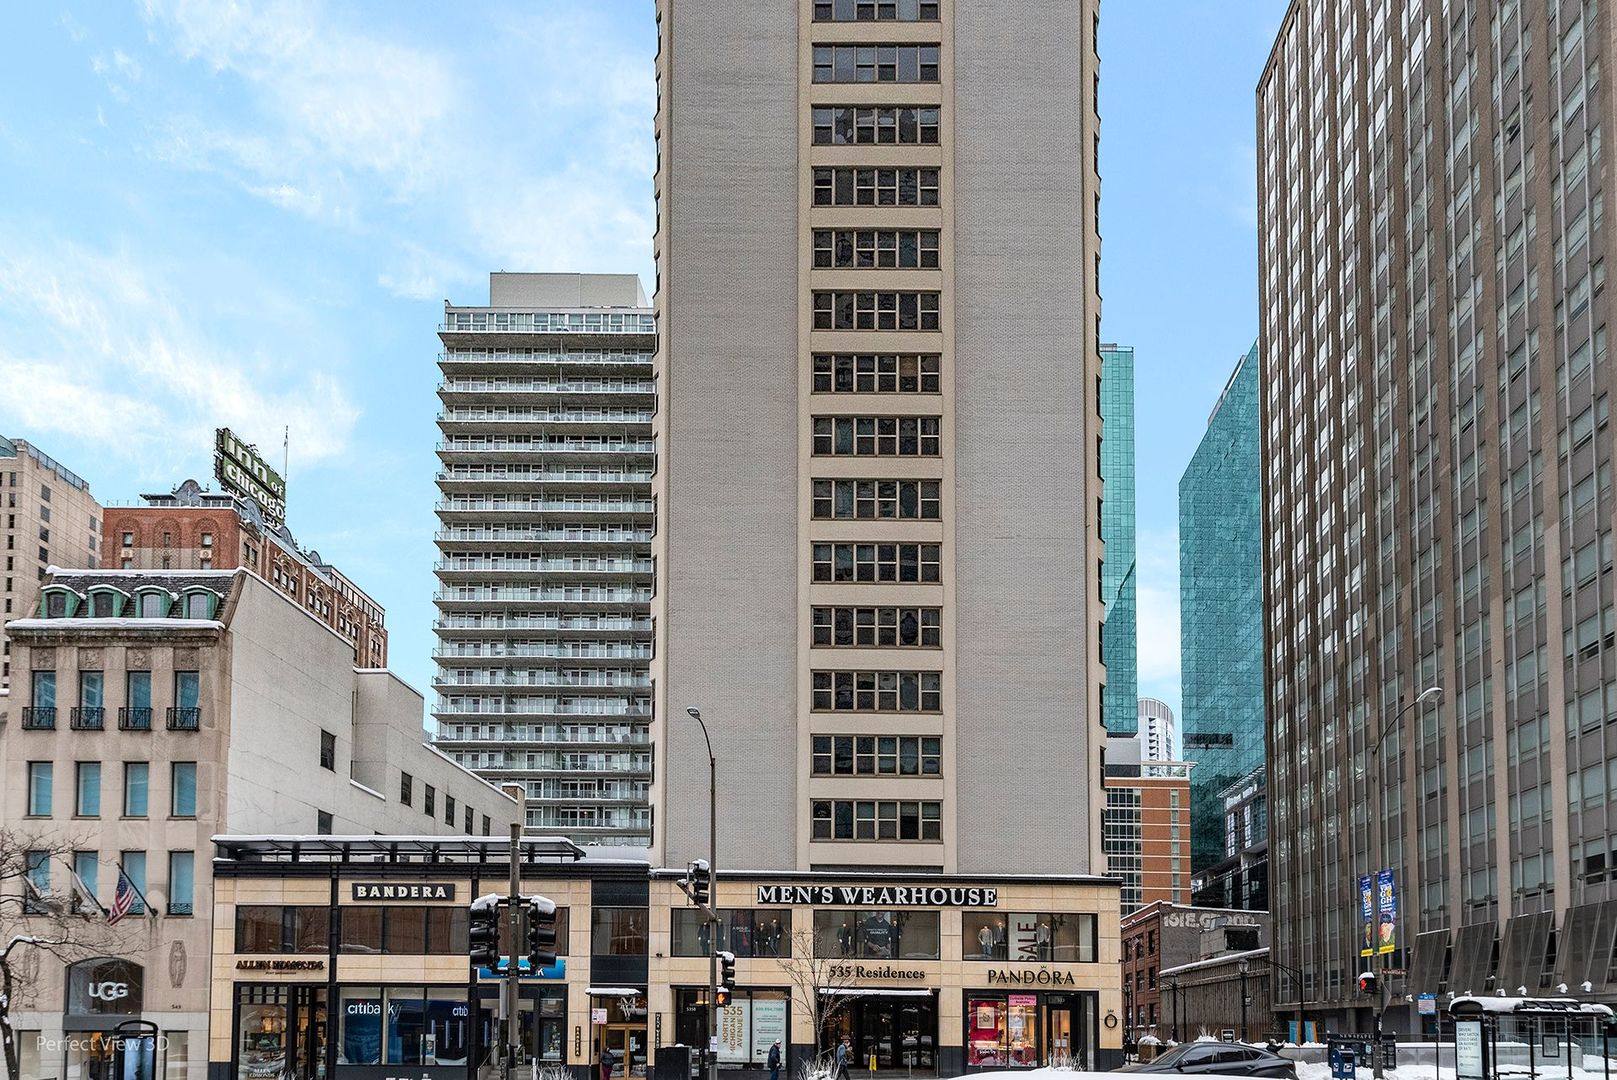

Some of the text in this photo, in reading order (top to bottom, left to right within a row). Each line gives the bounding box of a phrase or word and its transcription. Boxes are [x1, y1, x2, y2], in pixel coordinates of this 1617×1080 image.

[357, 886, 447, 898] BANDERA
[757, 886, 998, 906] MEN'S WEARHOUSE
[1017, 922, 1038, 961] SALE
[235, 960, 272, 970] ALLEN
[829, 965, 926, 979] 535 Residences
[987, 968, 1076, 985] PANDORA
[88, 981, 129, 1001] UGG
[347, 1002, 395, 1015] citibak
[452, 1005, 469, 1017] citib
[723, 1006, 743, 1016] 535
